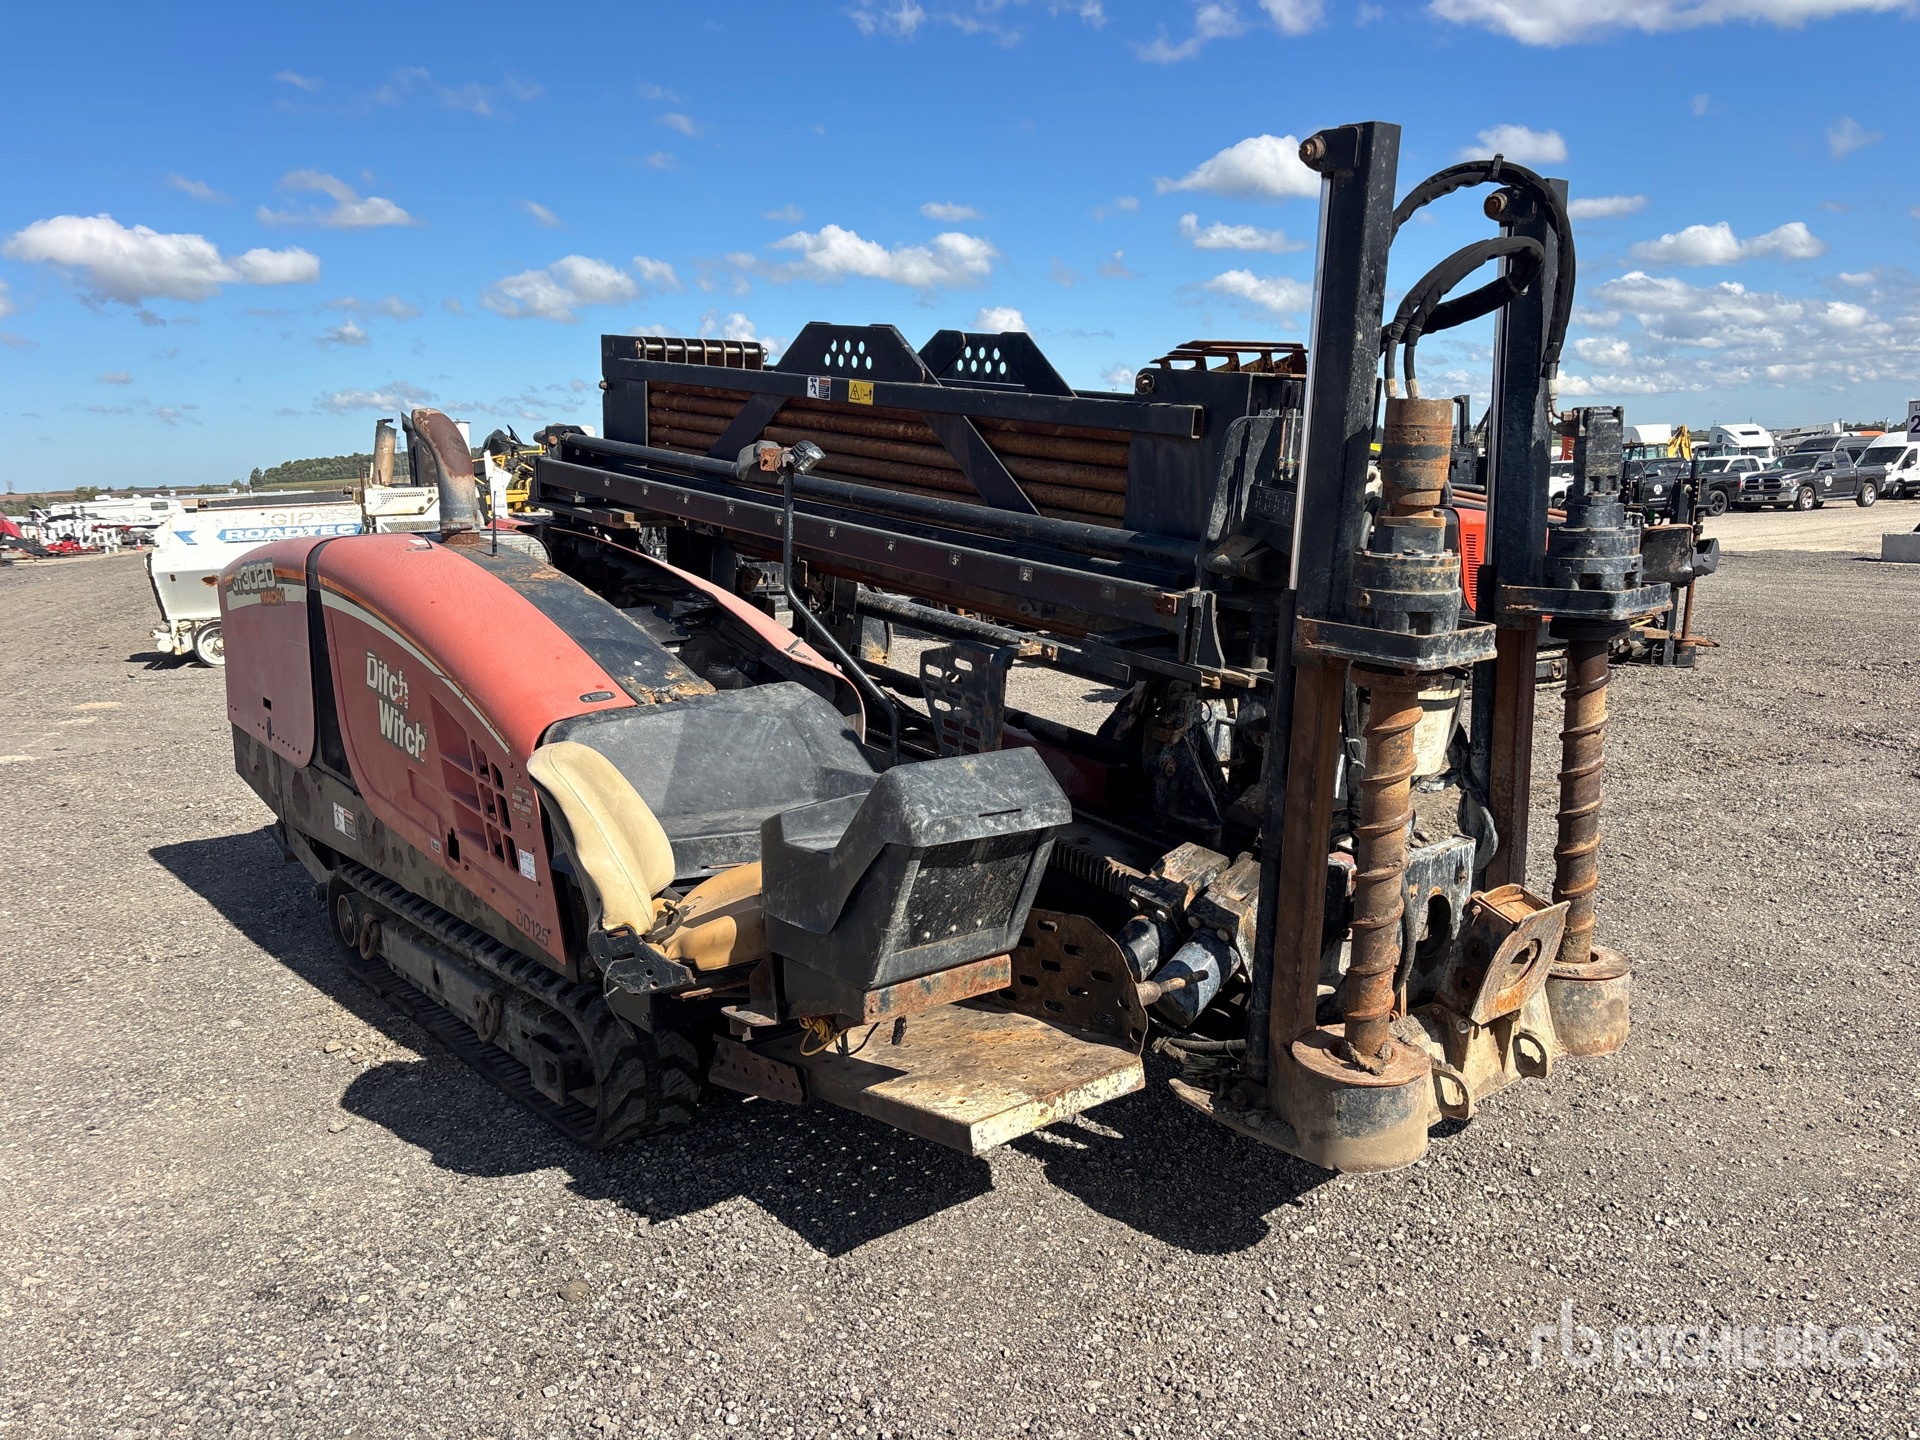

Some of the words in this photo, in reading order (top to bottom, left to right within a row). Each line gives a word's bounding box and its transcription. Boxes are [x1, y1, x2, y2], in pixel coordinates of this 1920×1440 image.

[225, 524, 356, 540] ROADTEC
[366, 651, 409, 710] Ditch
[378, 699, 427, 763] Witch
